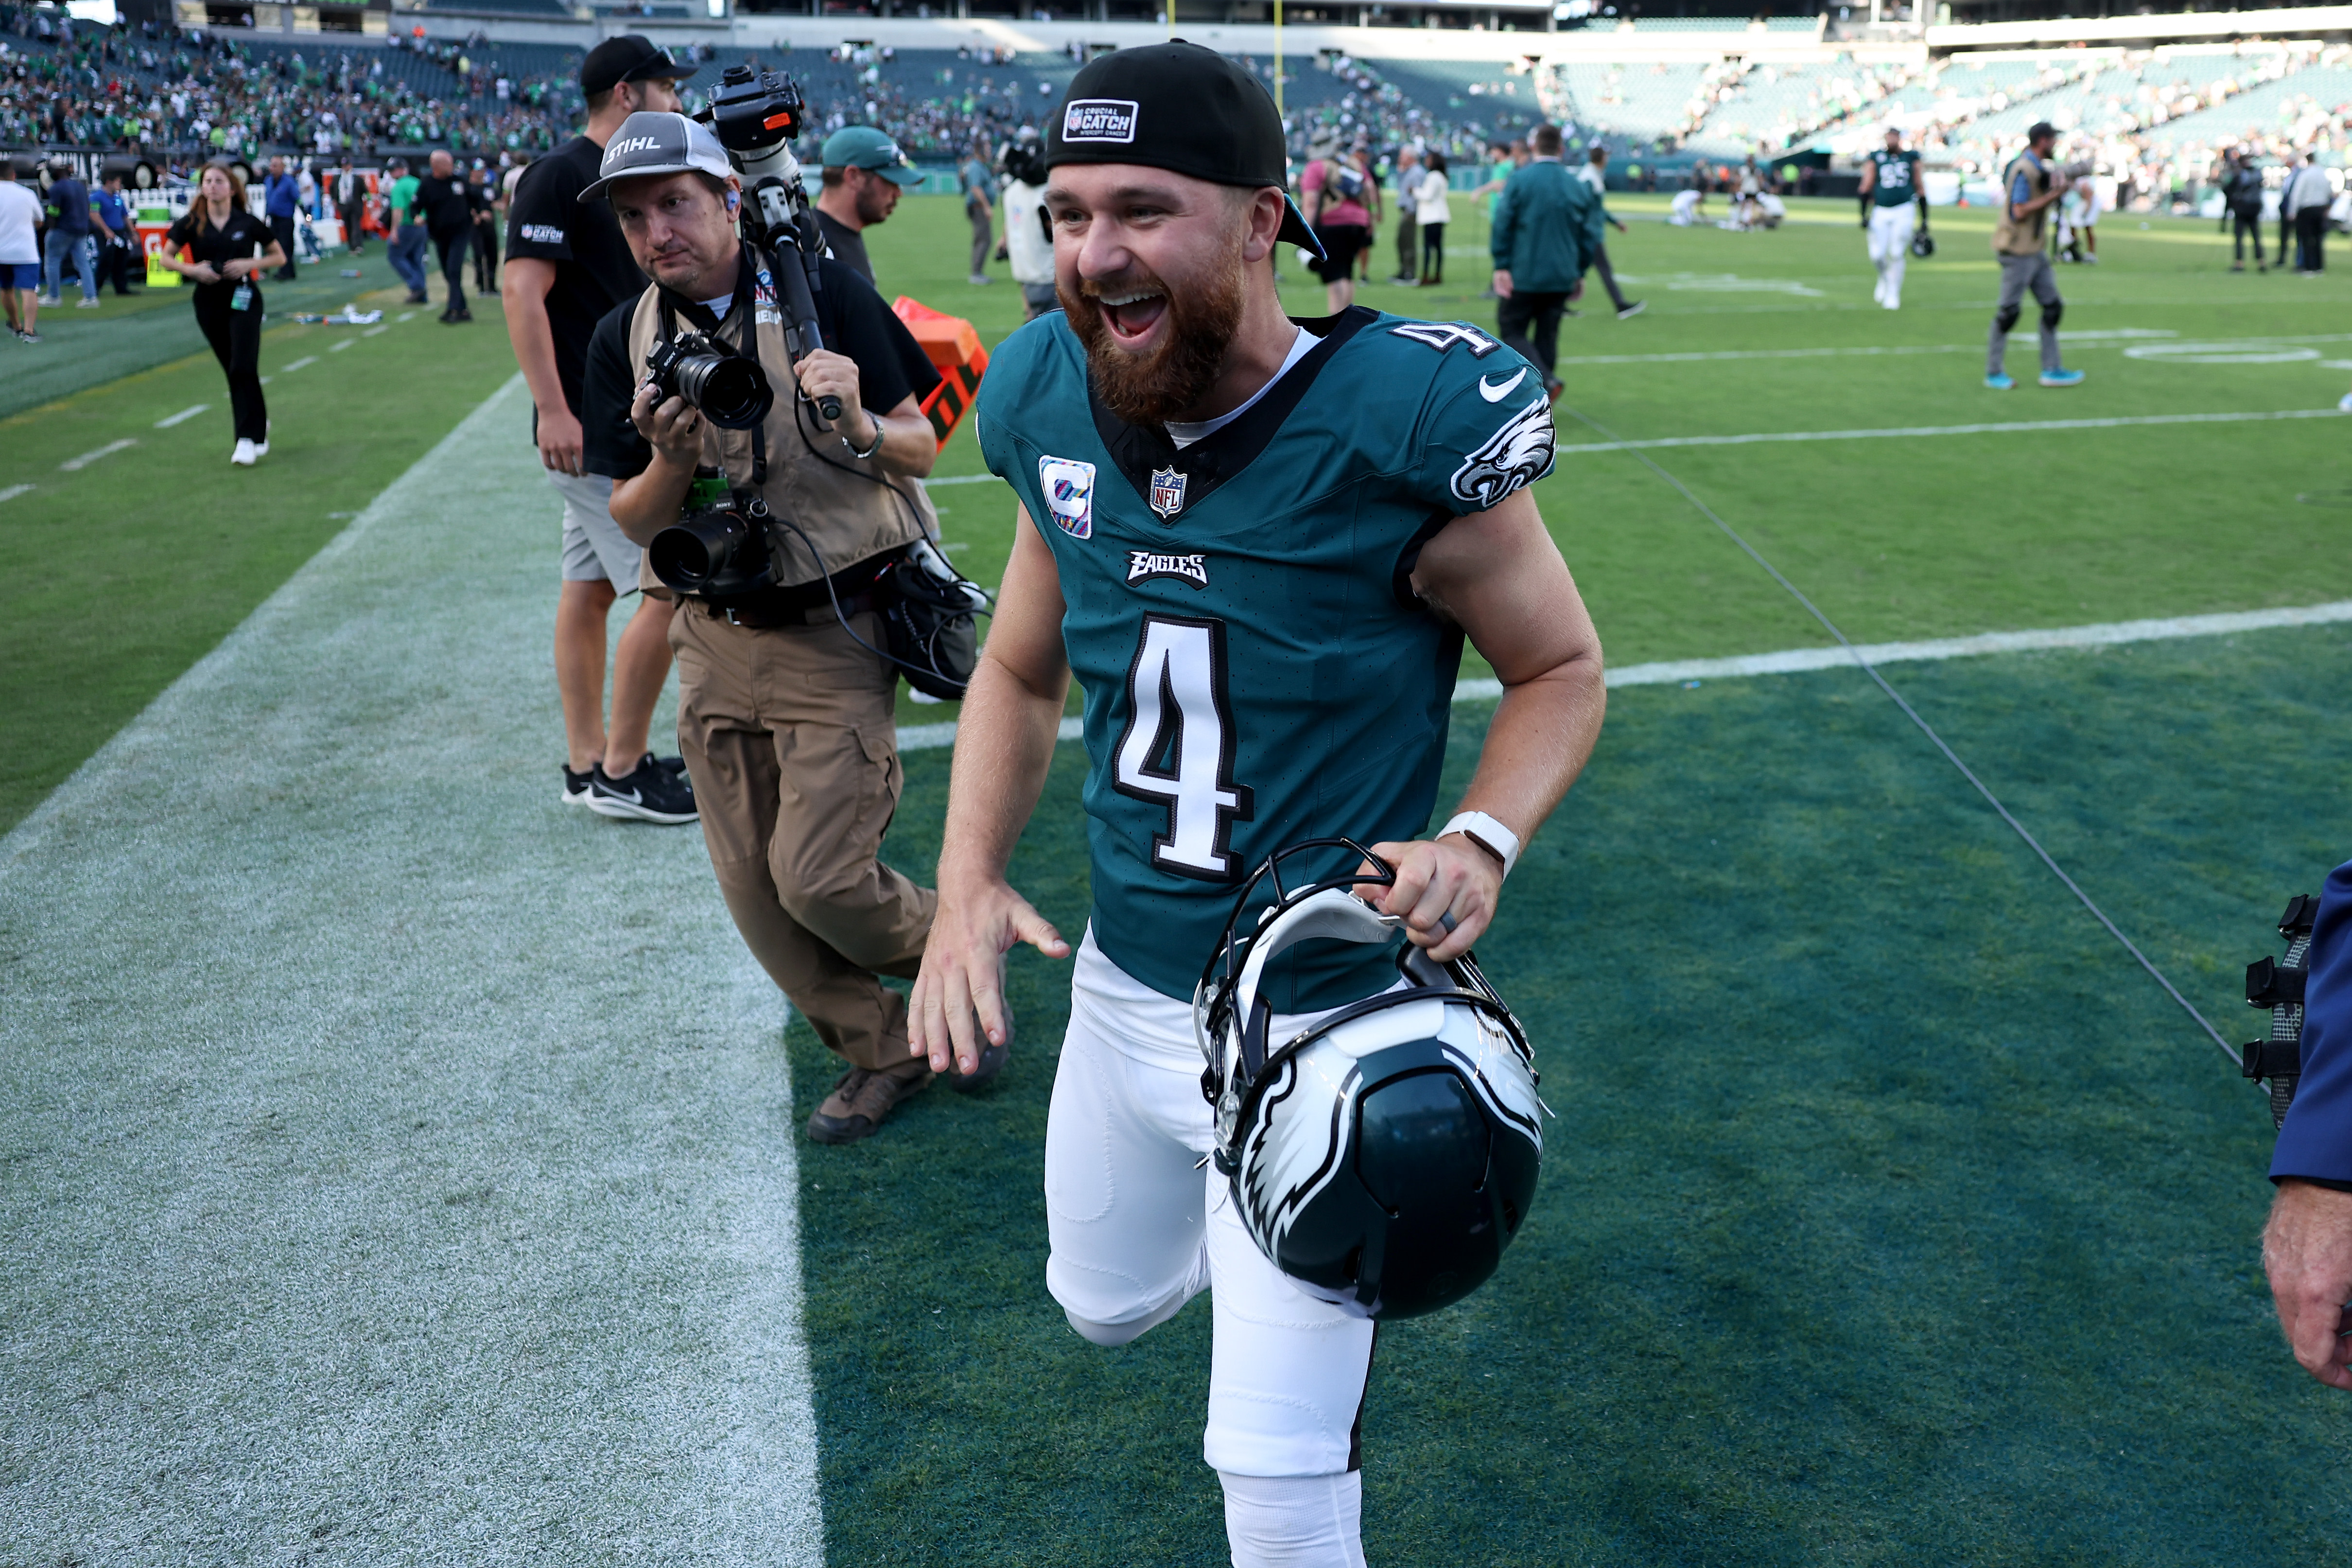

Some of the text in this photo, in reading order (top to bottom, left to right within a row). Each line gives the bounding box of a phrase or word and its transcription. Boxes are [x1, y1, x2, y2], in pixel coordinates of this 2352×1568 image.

[1081, 115, 1131, 130] CATCH
[606, 137, 661, 165] STIHL
[533, 229, 564, 241] CATCH
[1390, 323, 1498, 356] 4
[663, 350, 676, 367] SONY
[1043, 463, 1088, 518] C
[1154, 488, 1178, 508] NFL
[1127, 551, 1207, 584] EAGLES
[1115, 613, 1245, 877] 4
